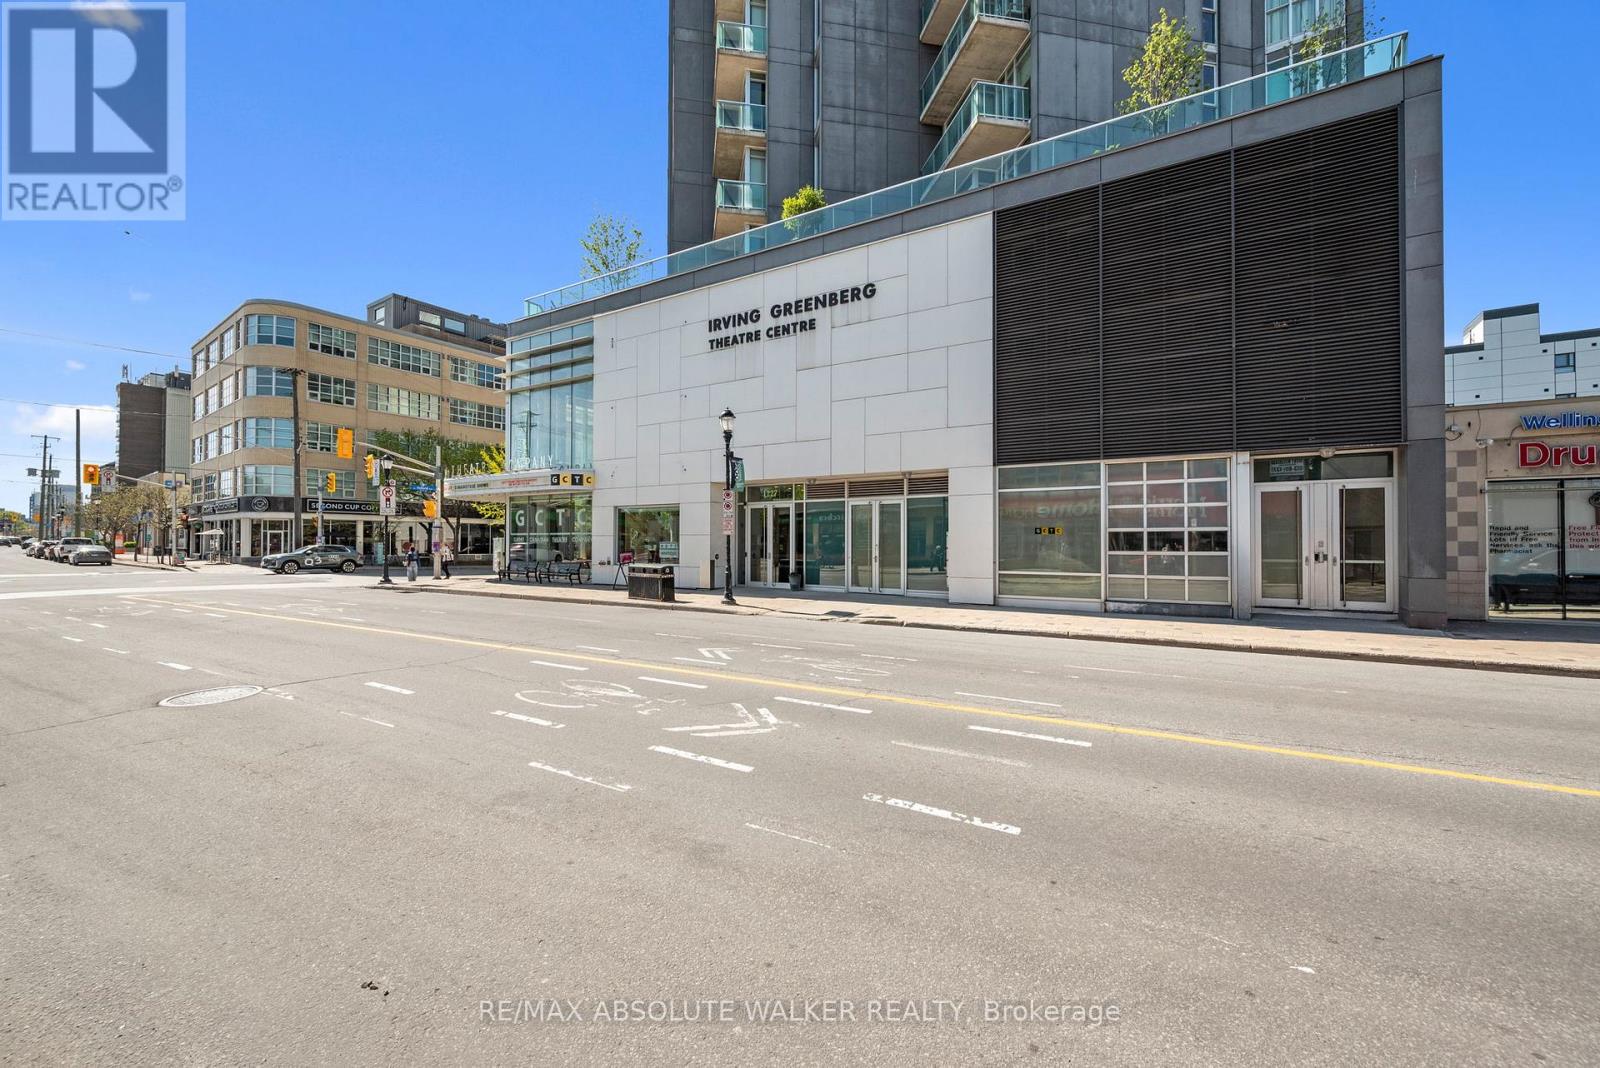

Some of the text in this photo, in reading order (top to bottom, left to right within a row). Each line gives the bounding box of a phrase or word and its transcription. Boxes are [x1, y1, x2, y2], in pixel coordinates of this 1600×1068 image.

[708, 283, 877, 333] IRVING GREENBERG
[708, 319, 816, 350] THEATRE CENTRE
[551, 475, 592, 485] GCTC
[515, 508, 586, 526] GCTC
[304, 556, 323, 567] Q3
